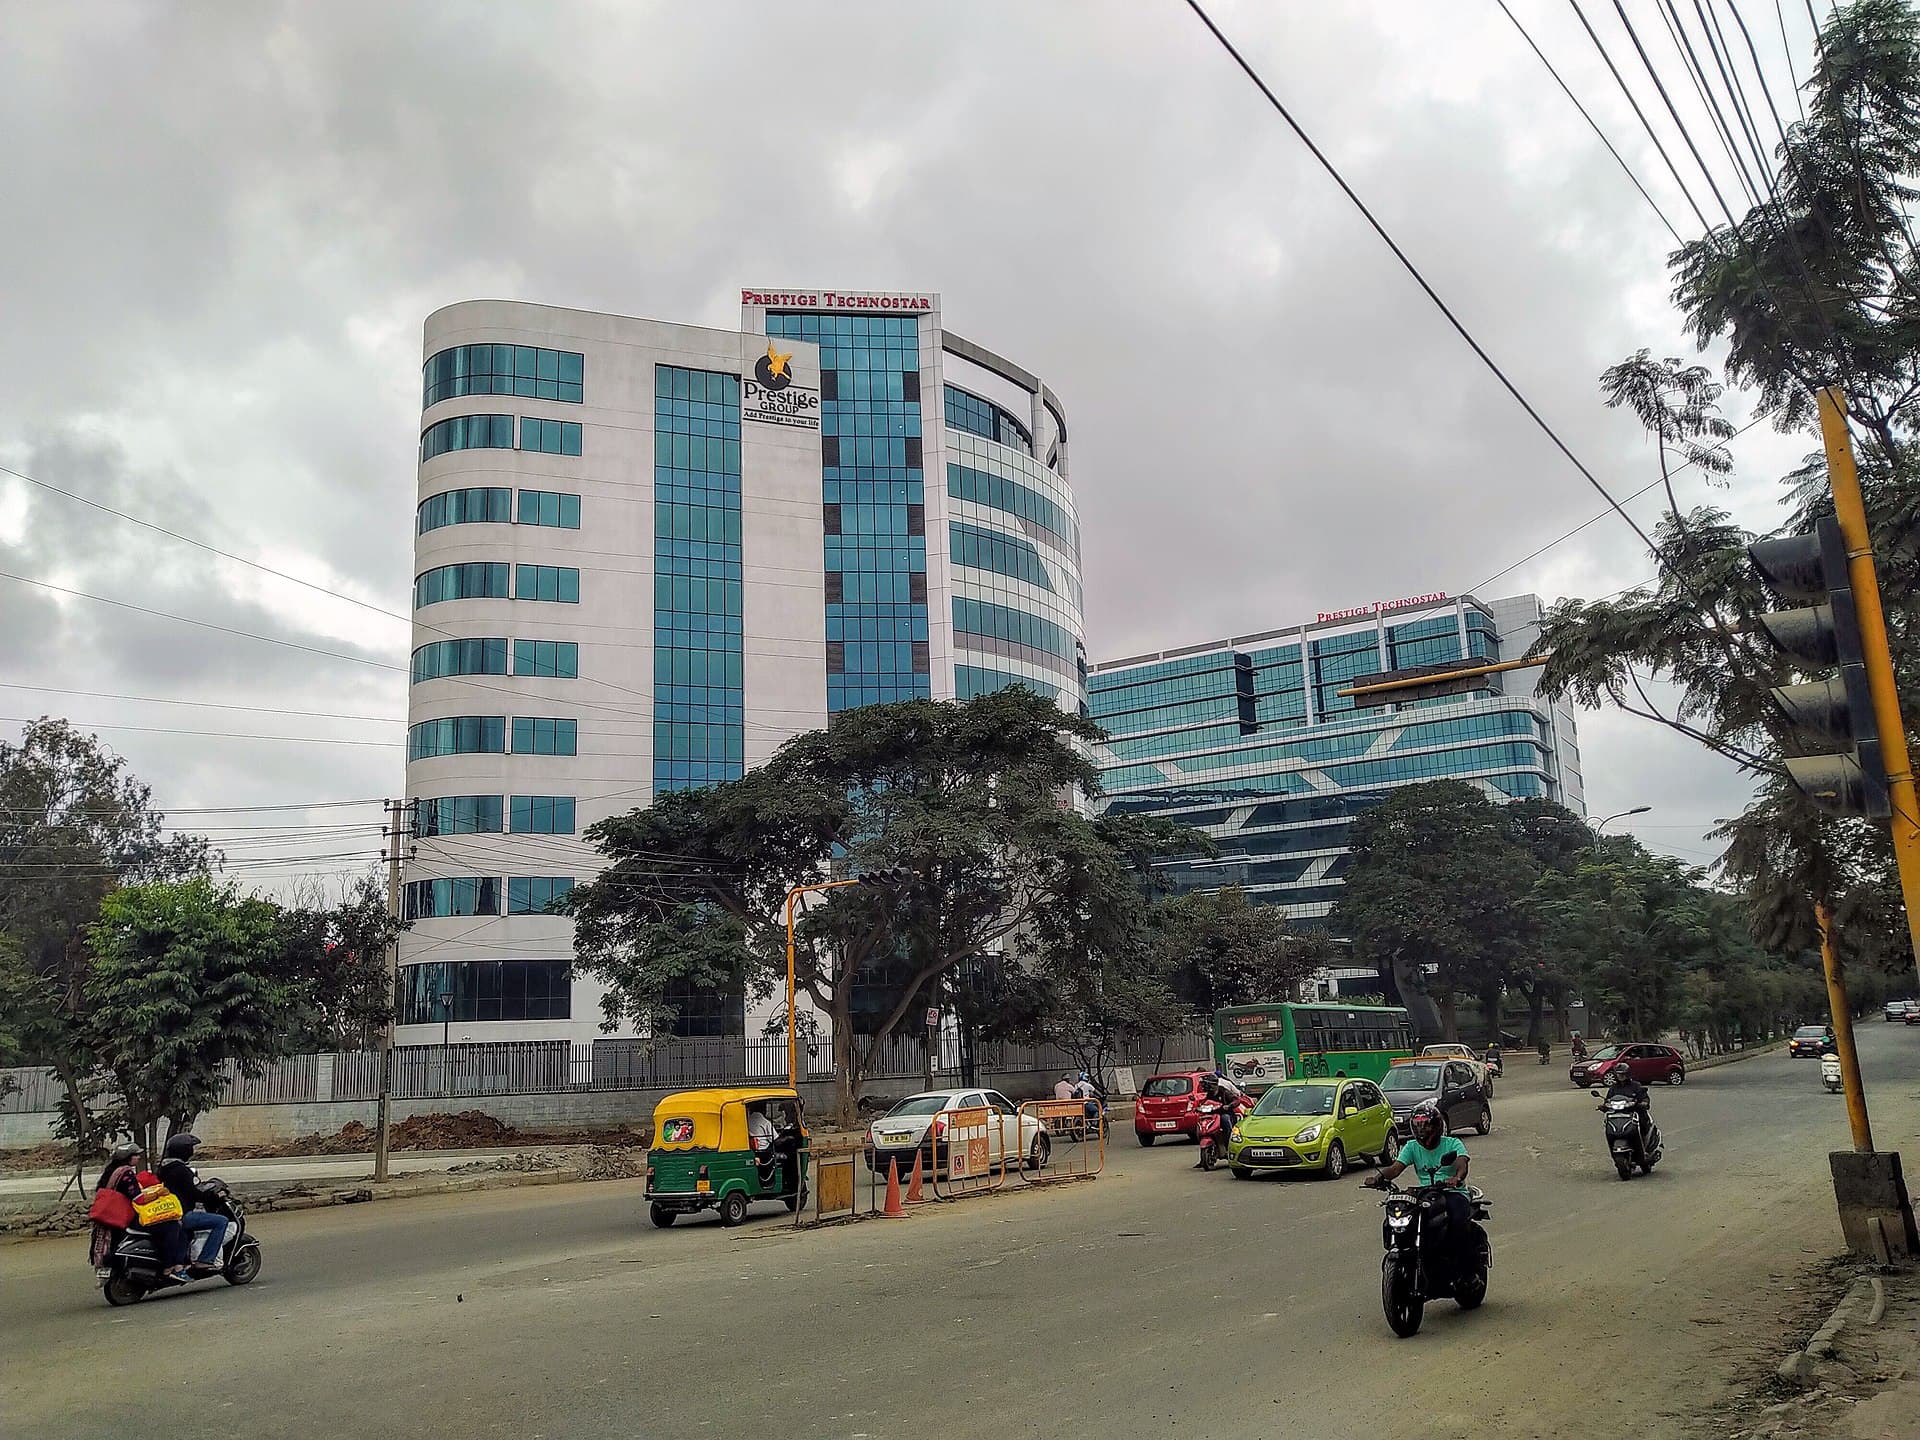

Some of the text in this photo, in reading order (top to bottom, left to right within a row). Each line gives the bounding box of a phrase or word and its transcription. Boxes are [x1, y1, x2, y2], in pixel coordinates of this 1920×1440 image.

[741, 291, 931, 309] PRESTIGE TECHNOSTAR
[743, 381, 819, 409] Prestige
[759, 401, 799, 414] GROUP
[758, 412, 784, 423] Prestige
[792, 418, 807, 426] your
[808, 418, 819, 427] life
[1316, 591, 1448, 624] PRESTIGE TECHNOSTAR
